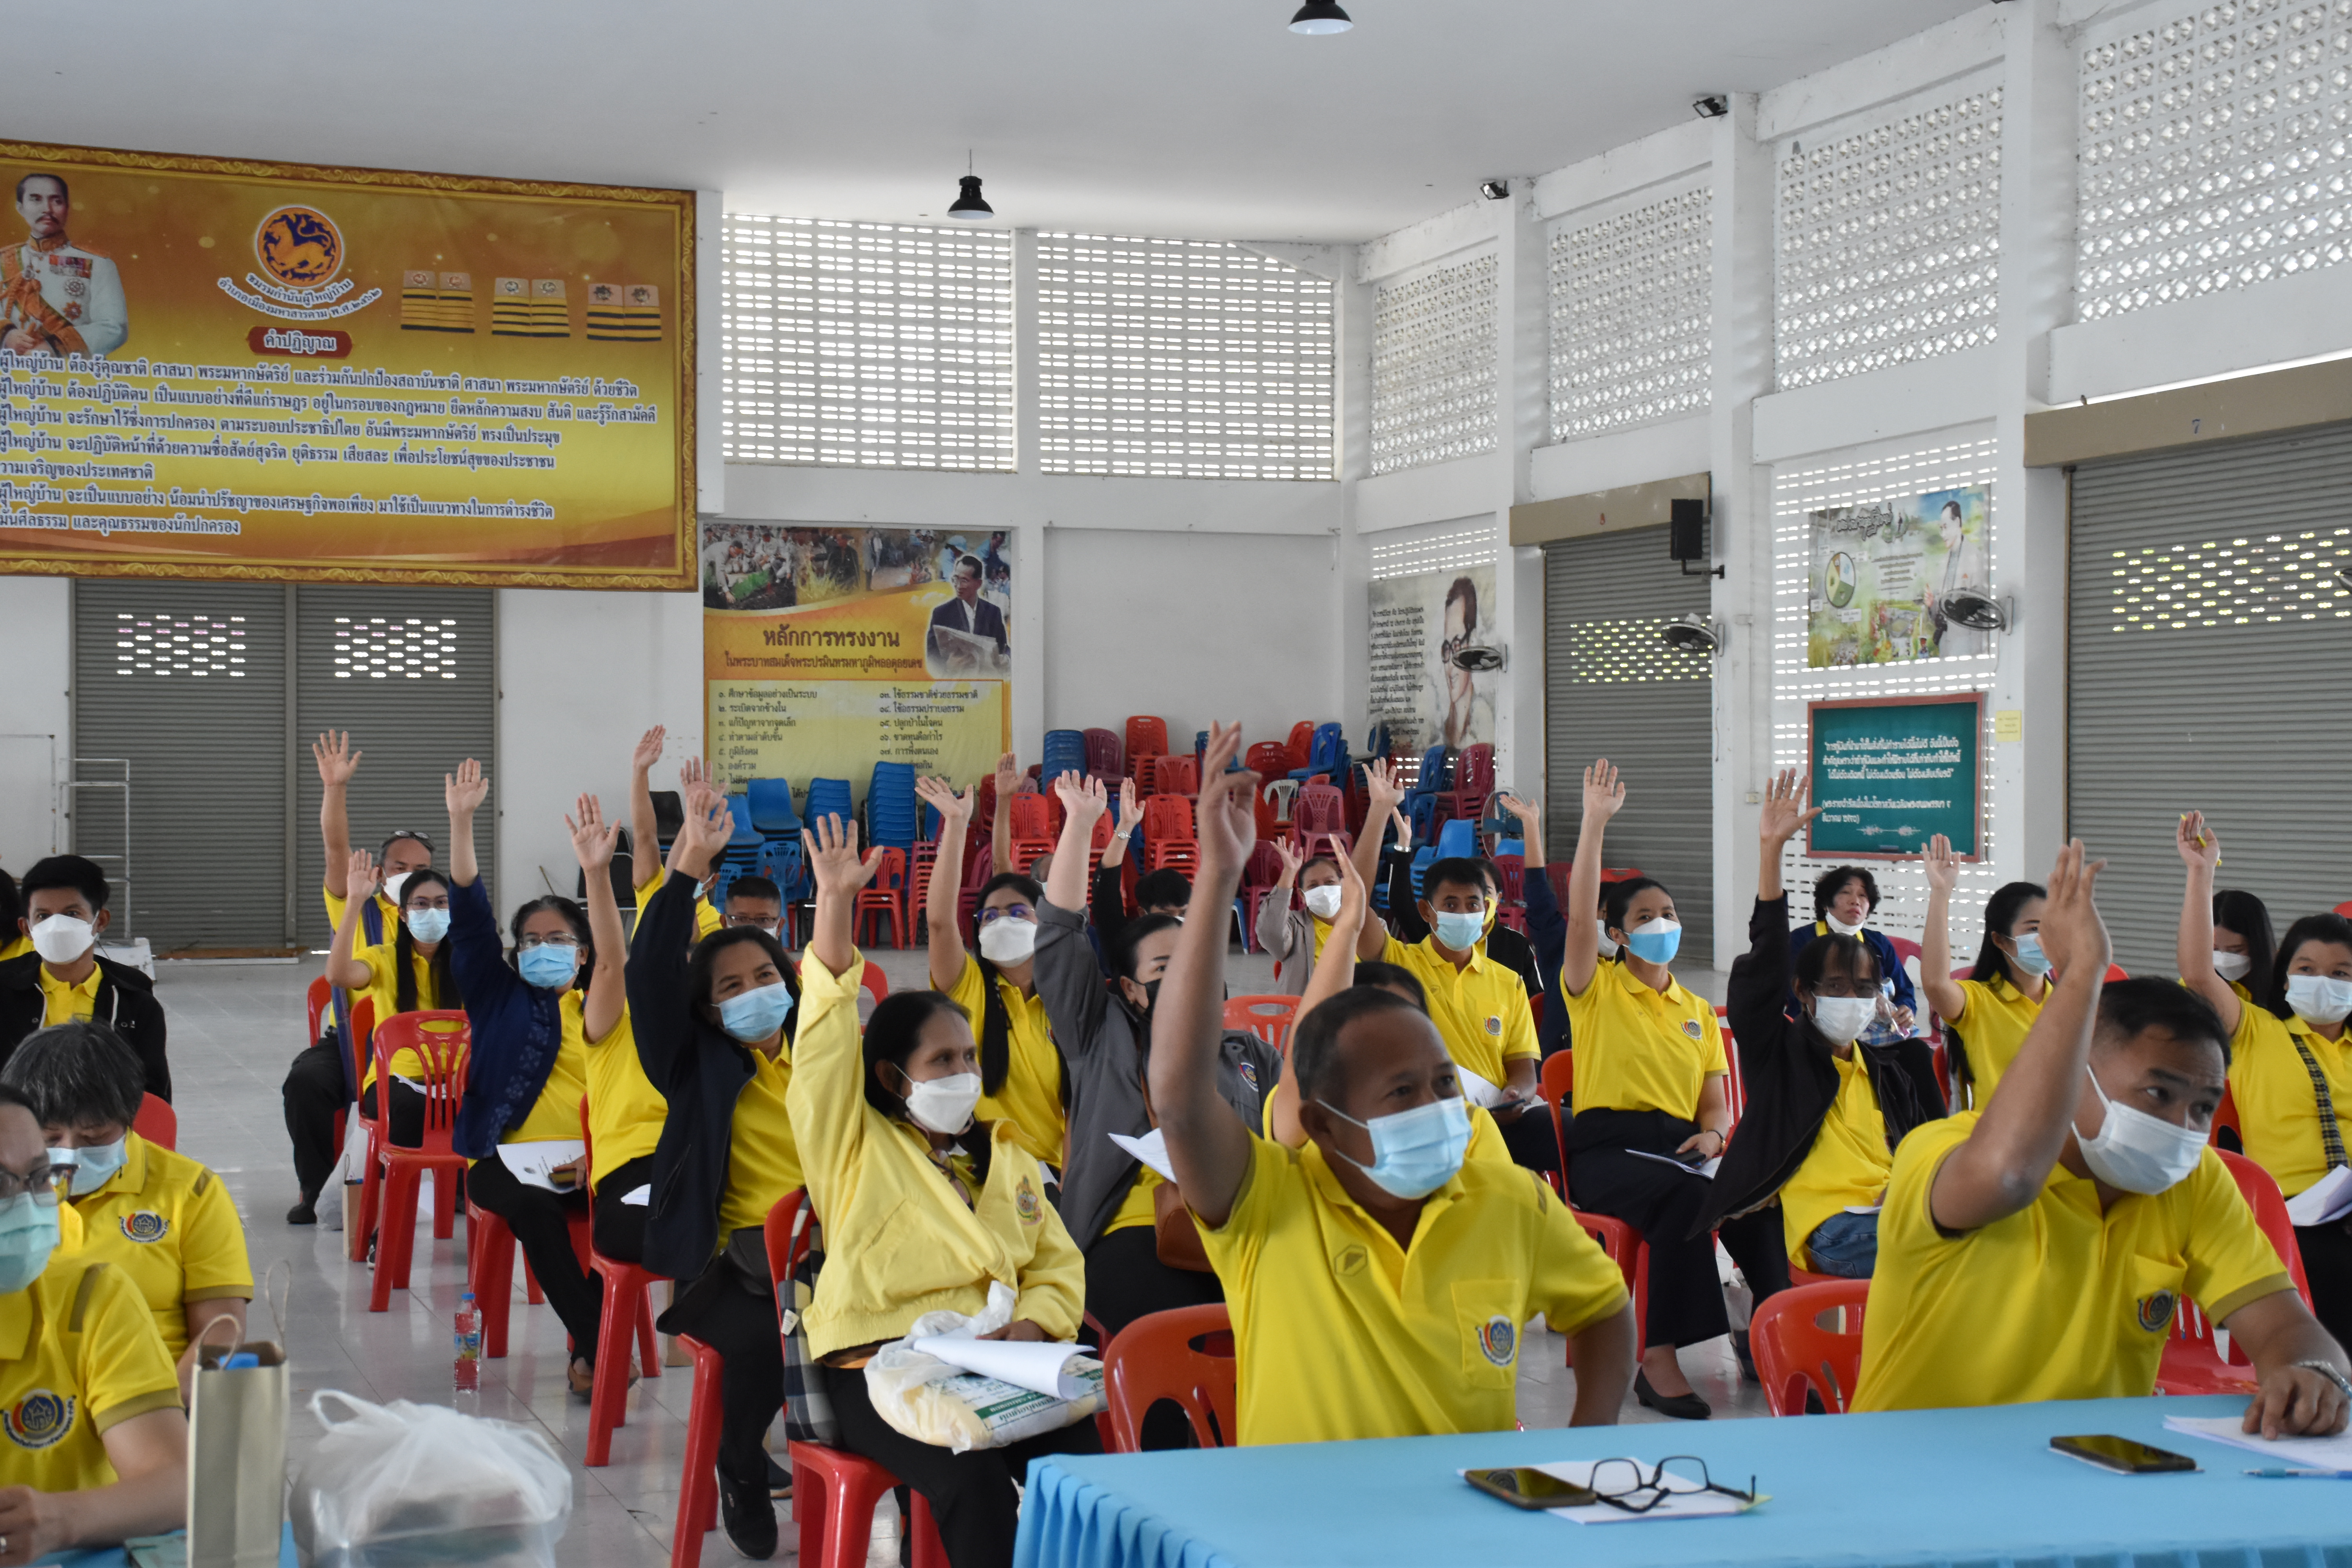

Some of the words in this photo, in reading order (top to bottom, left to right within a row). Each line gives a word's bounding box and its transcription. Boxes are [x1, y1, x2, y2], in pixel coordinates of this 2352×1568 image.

[219, 278, 328, 319] อำเภอเมืองมหาสารคาม
[247, 274, 352, 306] ชมรมกำนันผู้ใหญ่บ้าน
[266, 330, 335, 352] คำปฏิญาณ
[0, 350, 63, 373] ผู้ใหญ่บ้าน
[69, 355, 146, 378] ต้องรู้คุณชาติ
[153, 365, 192, 377] ศาสนา
[198, 364, 289, 382] พระมหากษัตริย์
[295, 367, 459, 390] และร่วมกันปกป้องสถาบันชาติ
[465, 379, 501, 391] ศาสนา
[506, 378, 588, 395] พระมหากษัตริย์
[593, 379, 637, 397] ด้วยชีวิต
[67, 380, 148, 403] ต้องปฏิบัติตน
[154, 384, 307, 412] เป็นแบบอย่างที่ดีแก่ราษฎร
[313, 392, 445, 417] อยู่ในกรอบของกฎหมาย
[450, 399, 543, 418] ยึดหลักความสงบ
[547, 402, 572, 419] สันติ
[577, 404, 656, 425] และรู้รักสามัคคี
[67, 405, 215, 430] จะรักษาไว้ซึ่งการปกครอง
[221, 419, 360, 436] ตามระบอบประชาธิปไตย
[366, 421, 476, 440] อันมีพระมหากษัตริย์
[482, 424, 560, 448] ทรงเป็นประมุข
[2192, 419, 2200, 434] 7
[292, 444, 338, 465] ยุติธรรม
[343, 445, 388, 463] เสียสละ
[394, 442, 555, 470] เพื่อประโยชน์สุขของประชาชน
[67, 484, 164, 505] จะเป็นแบบอย่าง
[169, 488, 374, 515] น้อมนำปรัชญาของเศรษฐกิจพอเพียง
[379, 495, 553, 518] มาใช้เป็นแนวทางในการดำรงชีวิต
[74, 514, 239, 535] และคุณธรรมของนักปกครอง
[763, 624, 900, 647] หลักการทรงงาน
